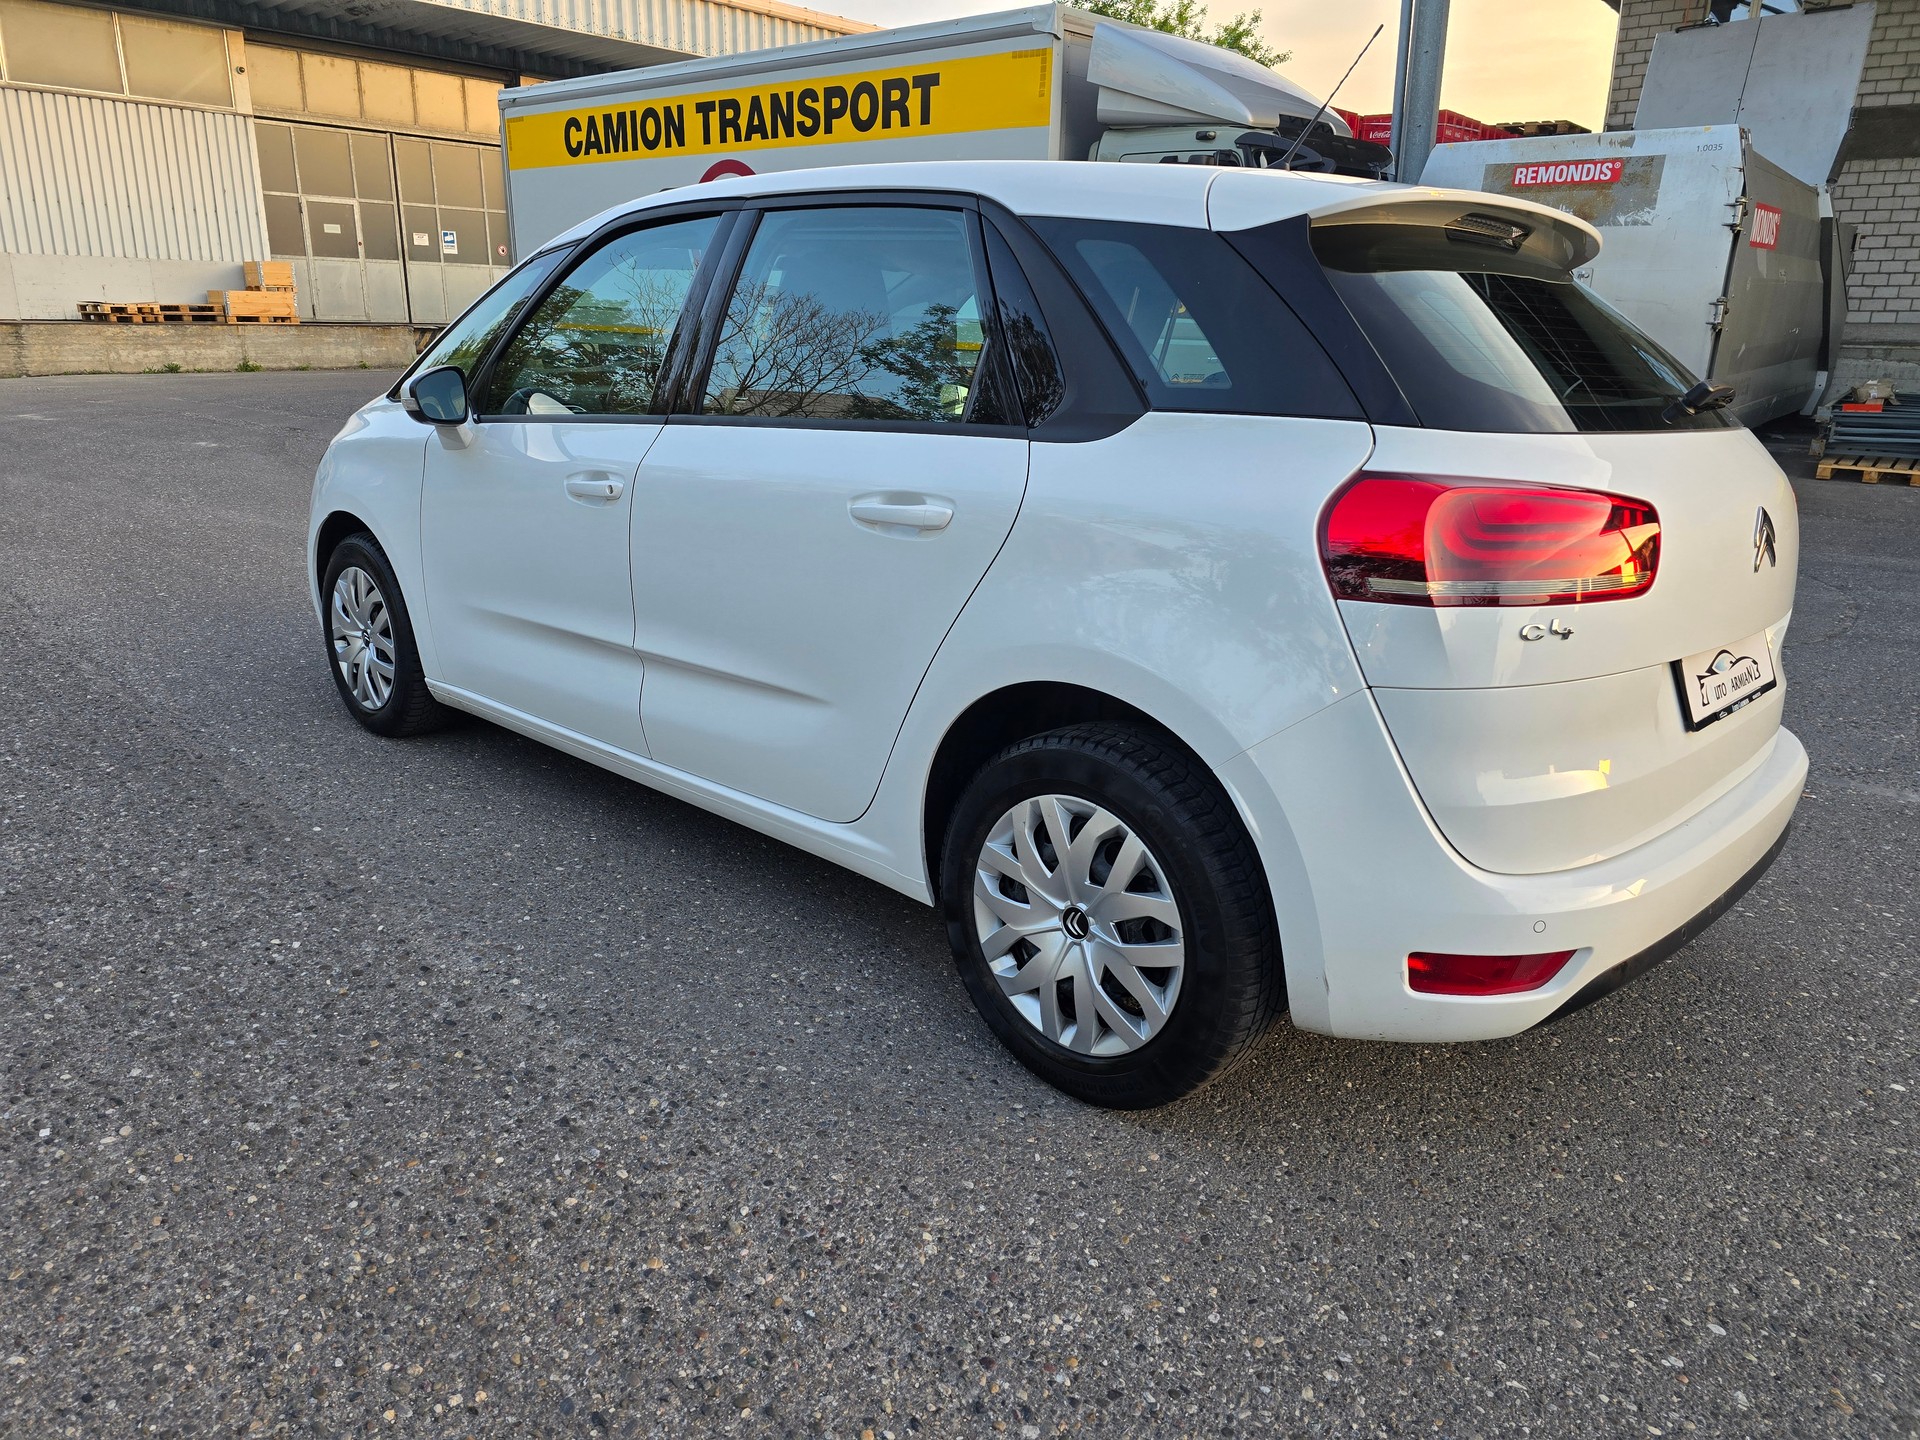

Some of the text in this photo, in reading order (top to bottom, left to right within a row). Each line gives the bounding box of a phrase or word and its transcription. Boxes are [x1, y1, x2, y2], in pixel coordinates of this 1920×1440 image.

[564, 72, 940, 158] CAMION TRANSPORT
[1697, 143, 1723, 152] 1.0035
[1519, 617, 1575, 641] C4
